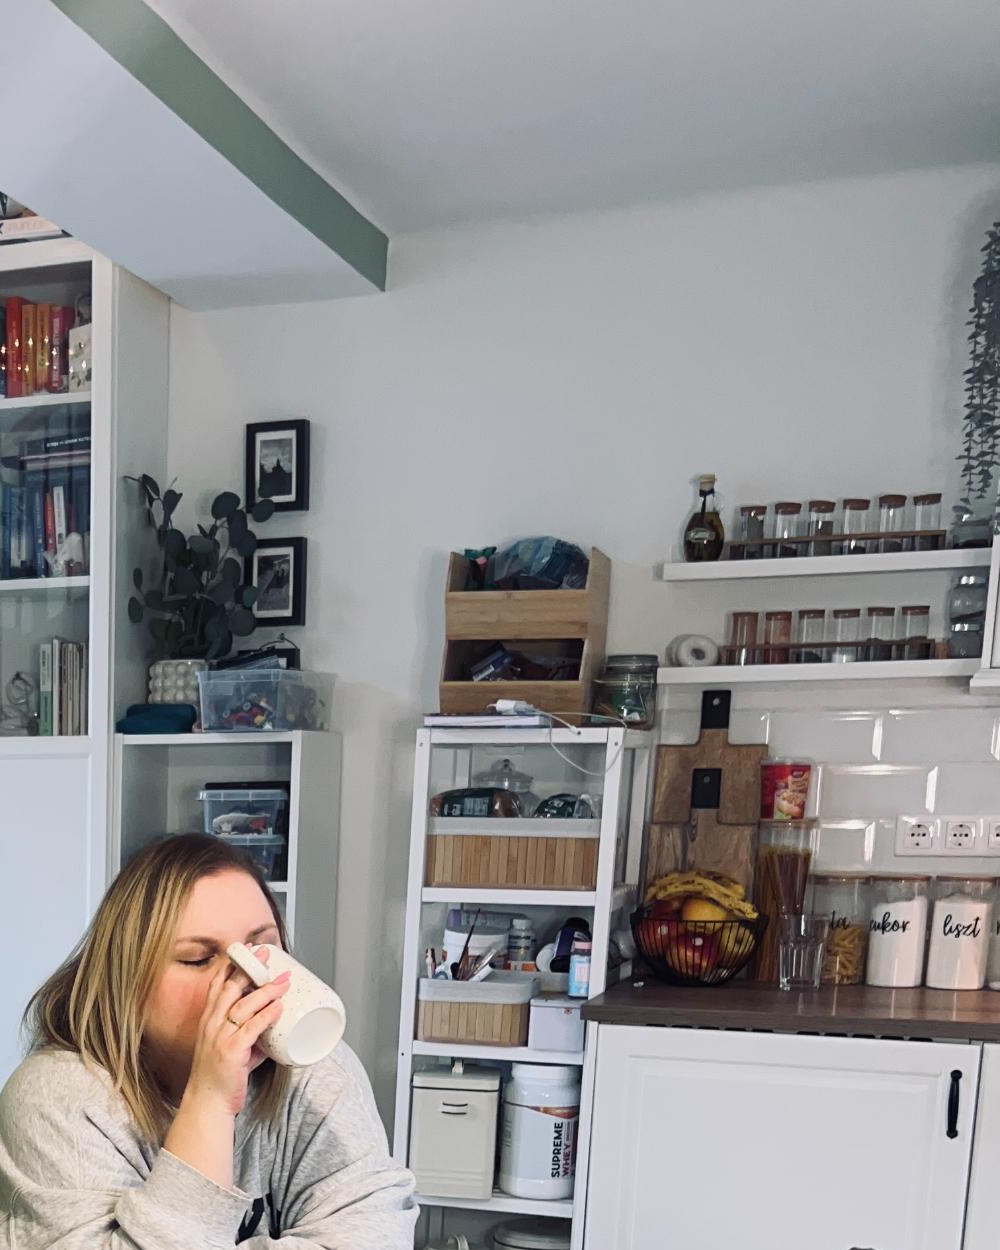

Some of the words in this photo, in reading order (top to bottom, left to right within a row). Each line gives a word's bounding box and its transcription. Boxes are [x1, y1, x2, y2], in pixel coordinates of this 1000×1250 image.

[942, 914, 981, 938] liszt
[551, 1122, 564, 1178] SUPREME
[562, 1144, 571, 1177] WHEY
